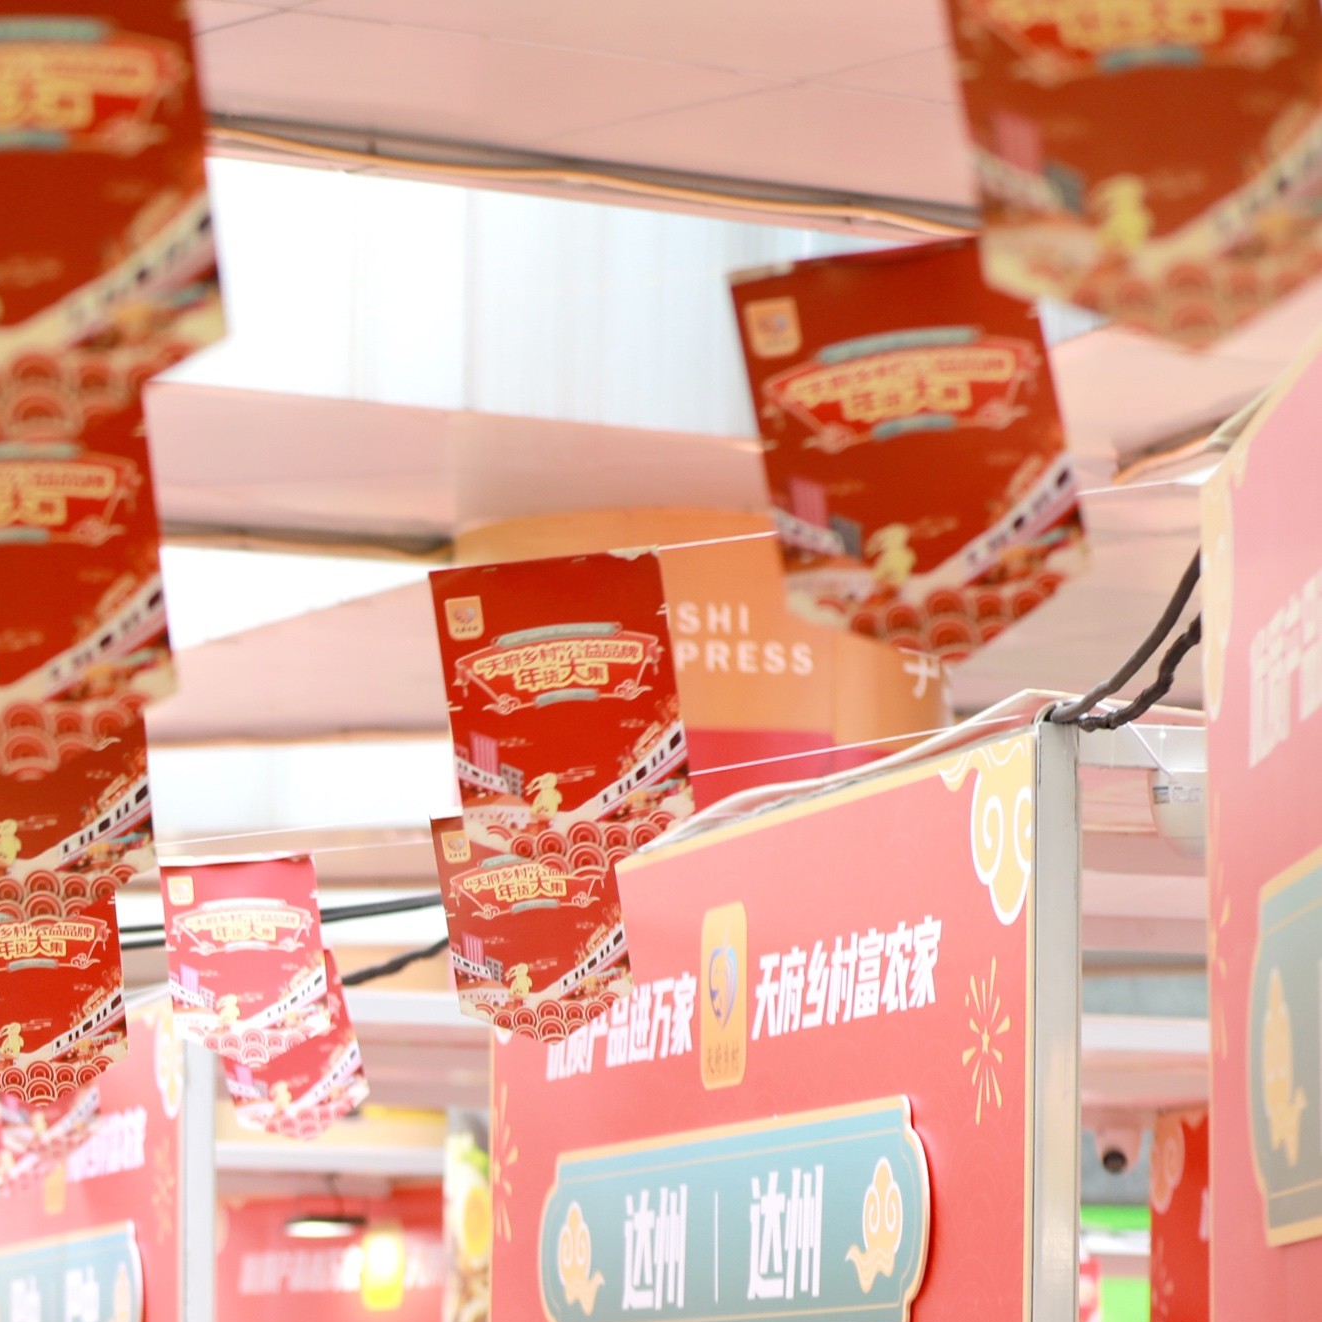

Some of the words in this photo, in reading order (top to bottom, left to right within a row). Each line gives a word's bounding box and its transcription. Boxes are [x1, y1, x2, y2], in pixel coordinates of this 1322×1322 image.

[751, 914, 942, 1041] 天府乡村富农家
[622, 1183, 688, 1311] 达州
[747, 1164, 825, 1301] 达州
